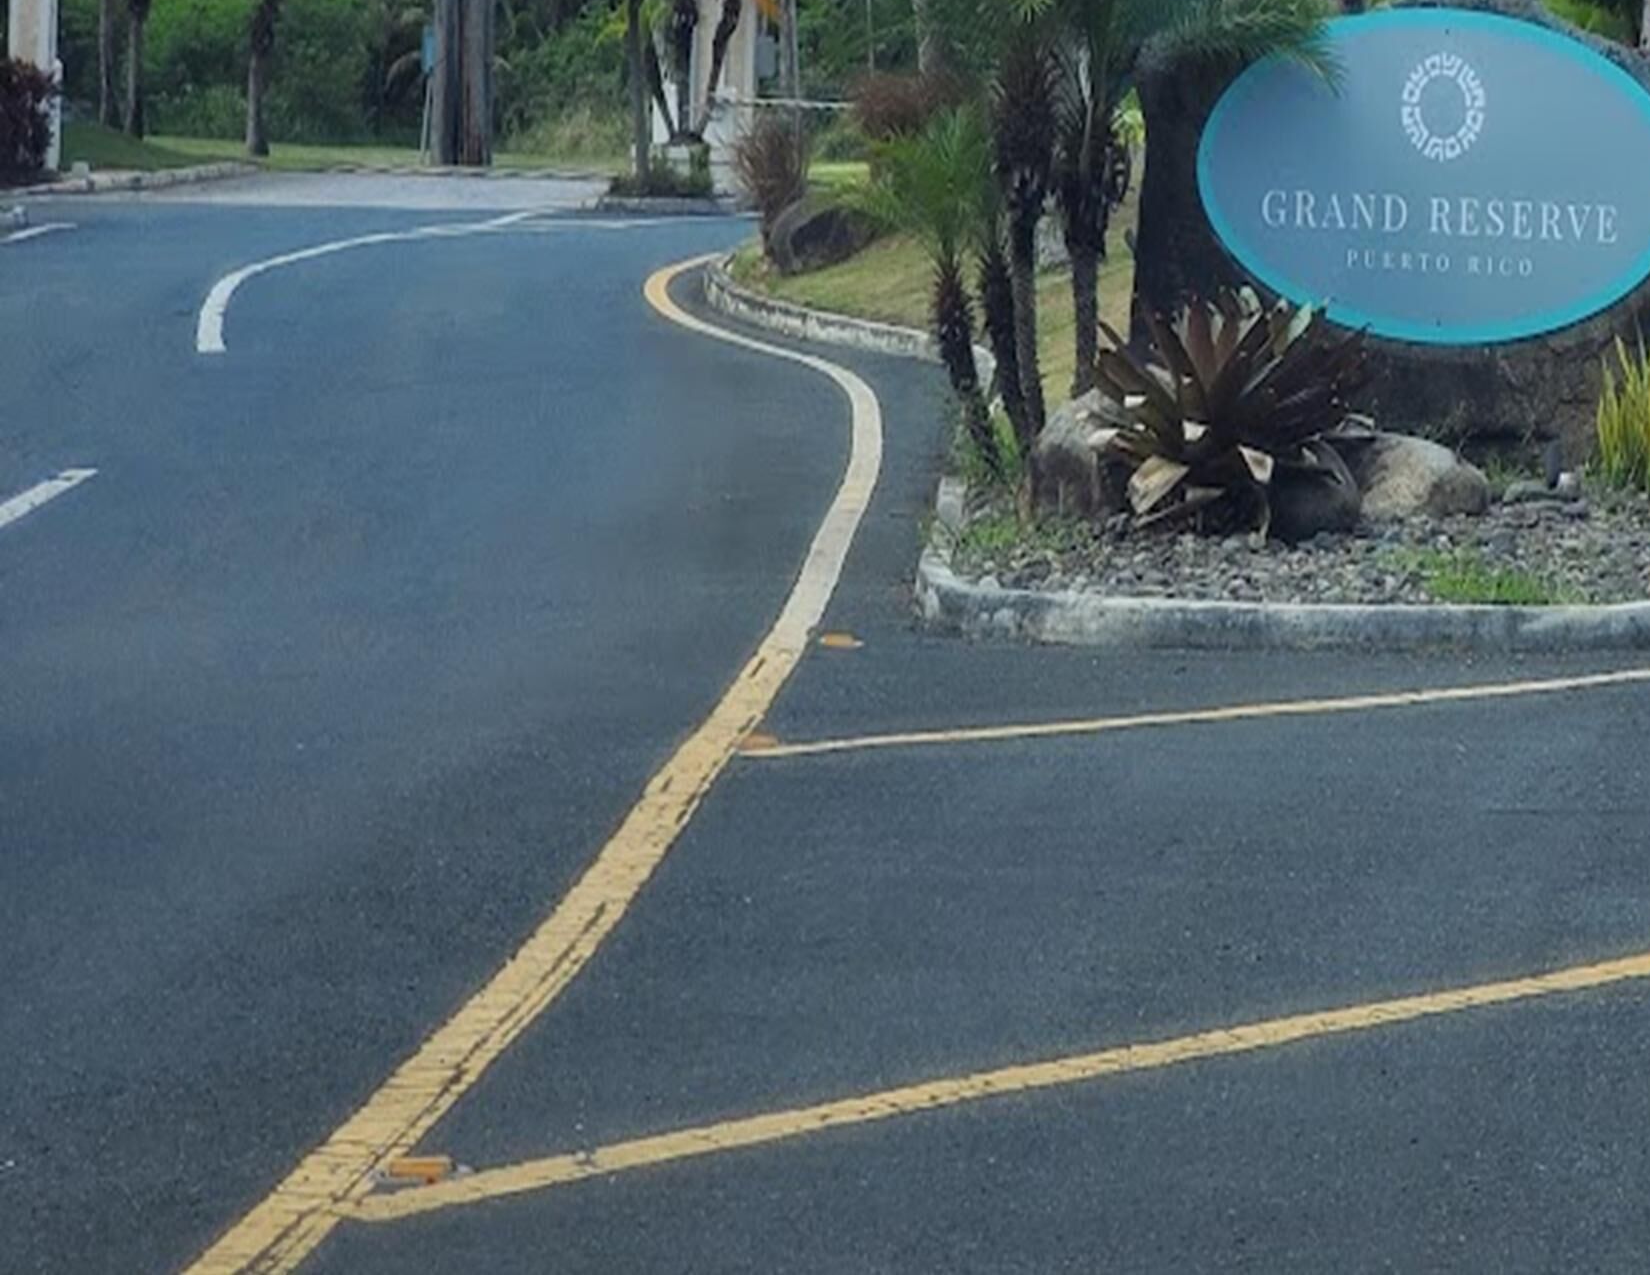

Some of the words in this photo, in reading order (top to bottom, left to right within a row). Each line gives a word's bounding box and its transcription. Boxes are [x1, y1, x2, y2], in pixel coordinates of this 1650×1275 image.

[1261, 190, 1408, 233] GRAND
[1429, 197, 1618, 243] RESERVE
[1346, 249, 1451, 274] PUERTO
[1467, 255, 1534, 277] RICO
